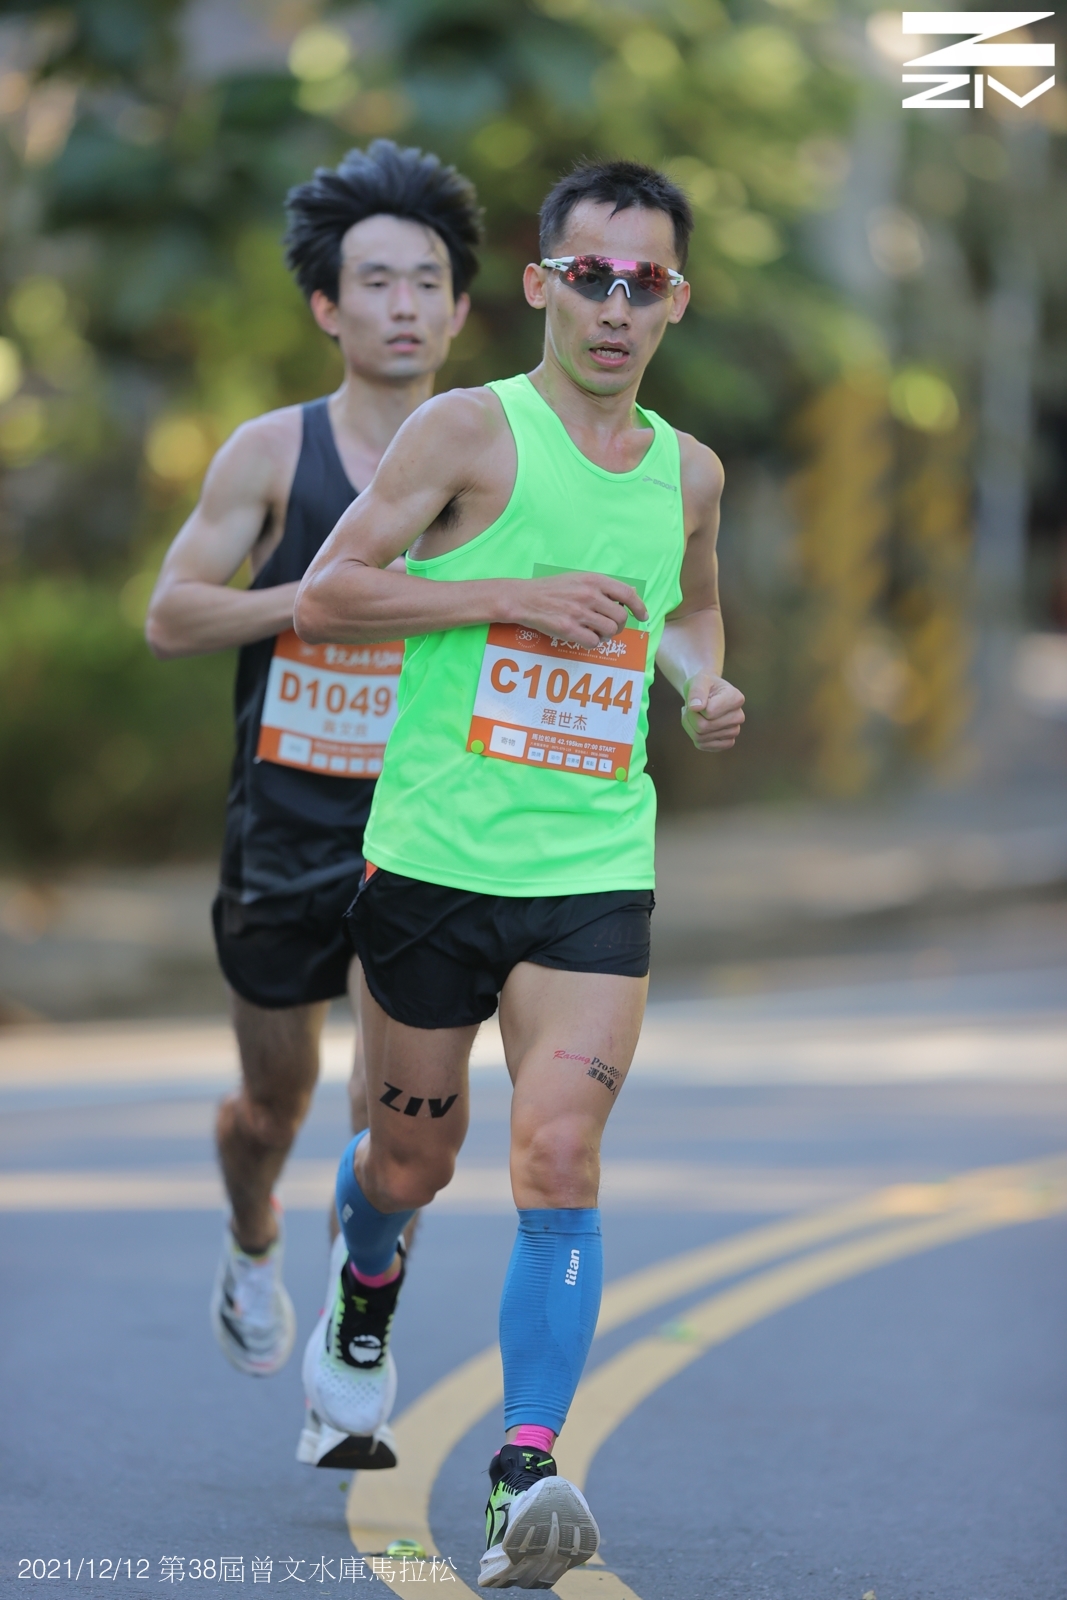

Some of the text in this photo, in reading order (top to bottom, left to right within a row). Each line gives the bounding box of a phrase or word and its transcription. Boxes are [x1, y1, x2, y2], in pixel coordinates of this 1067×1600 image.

[279, 670, 397, 717] D1049
[490, 658, 634, 715] C10444
[541, 708, 588, 731] 羅世杰
[557, 738, 583, 748] 42.195km
[553, 1050, 608, 1071] Racing Pro
[586, 1066, 618, 1095] 運動達人
[378, 1081, 459, 1118] ZIV
[565, 1249, 580, 1286] titan
